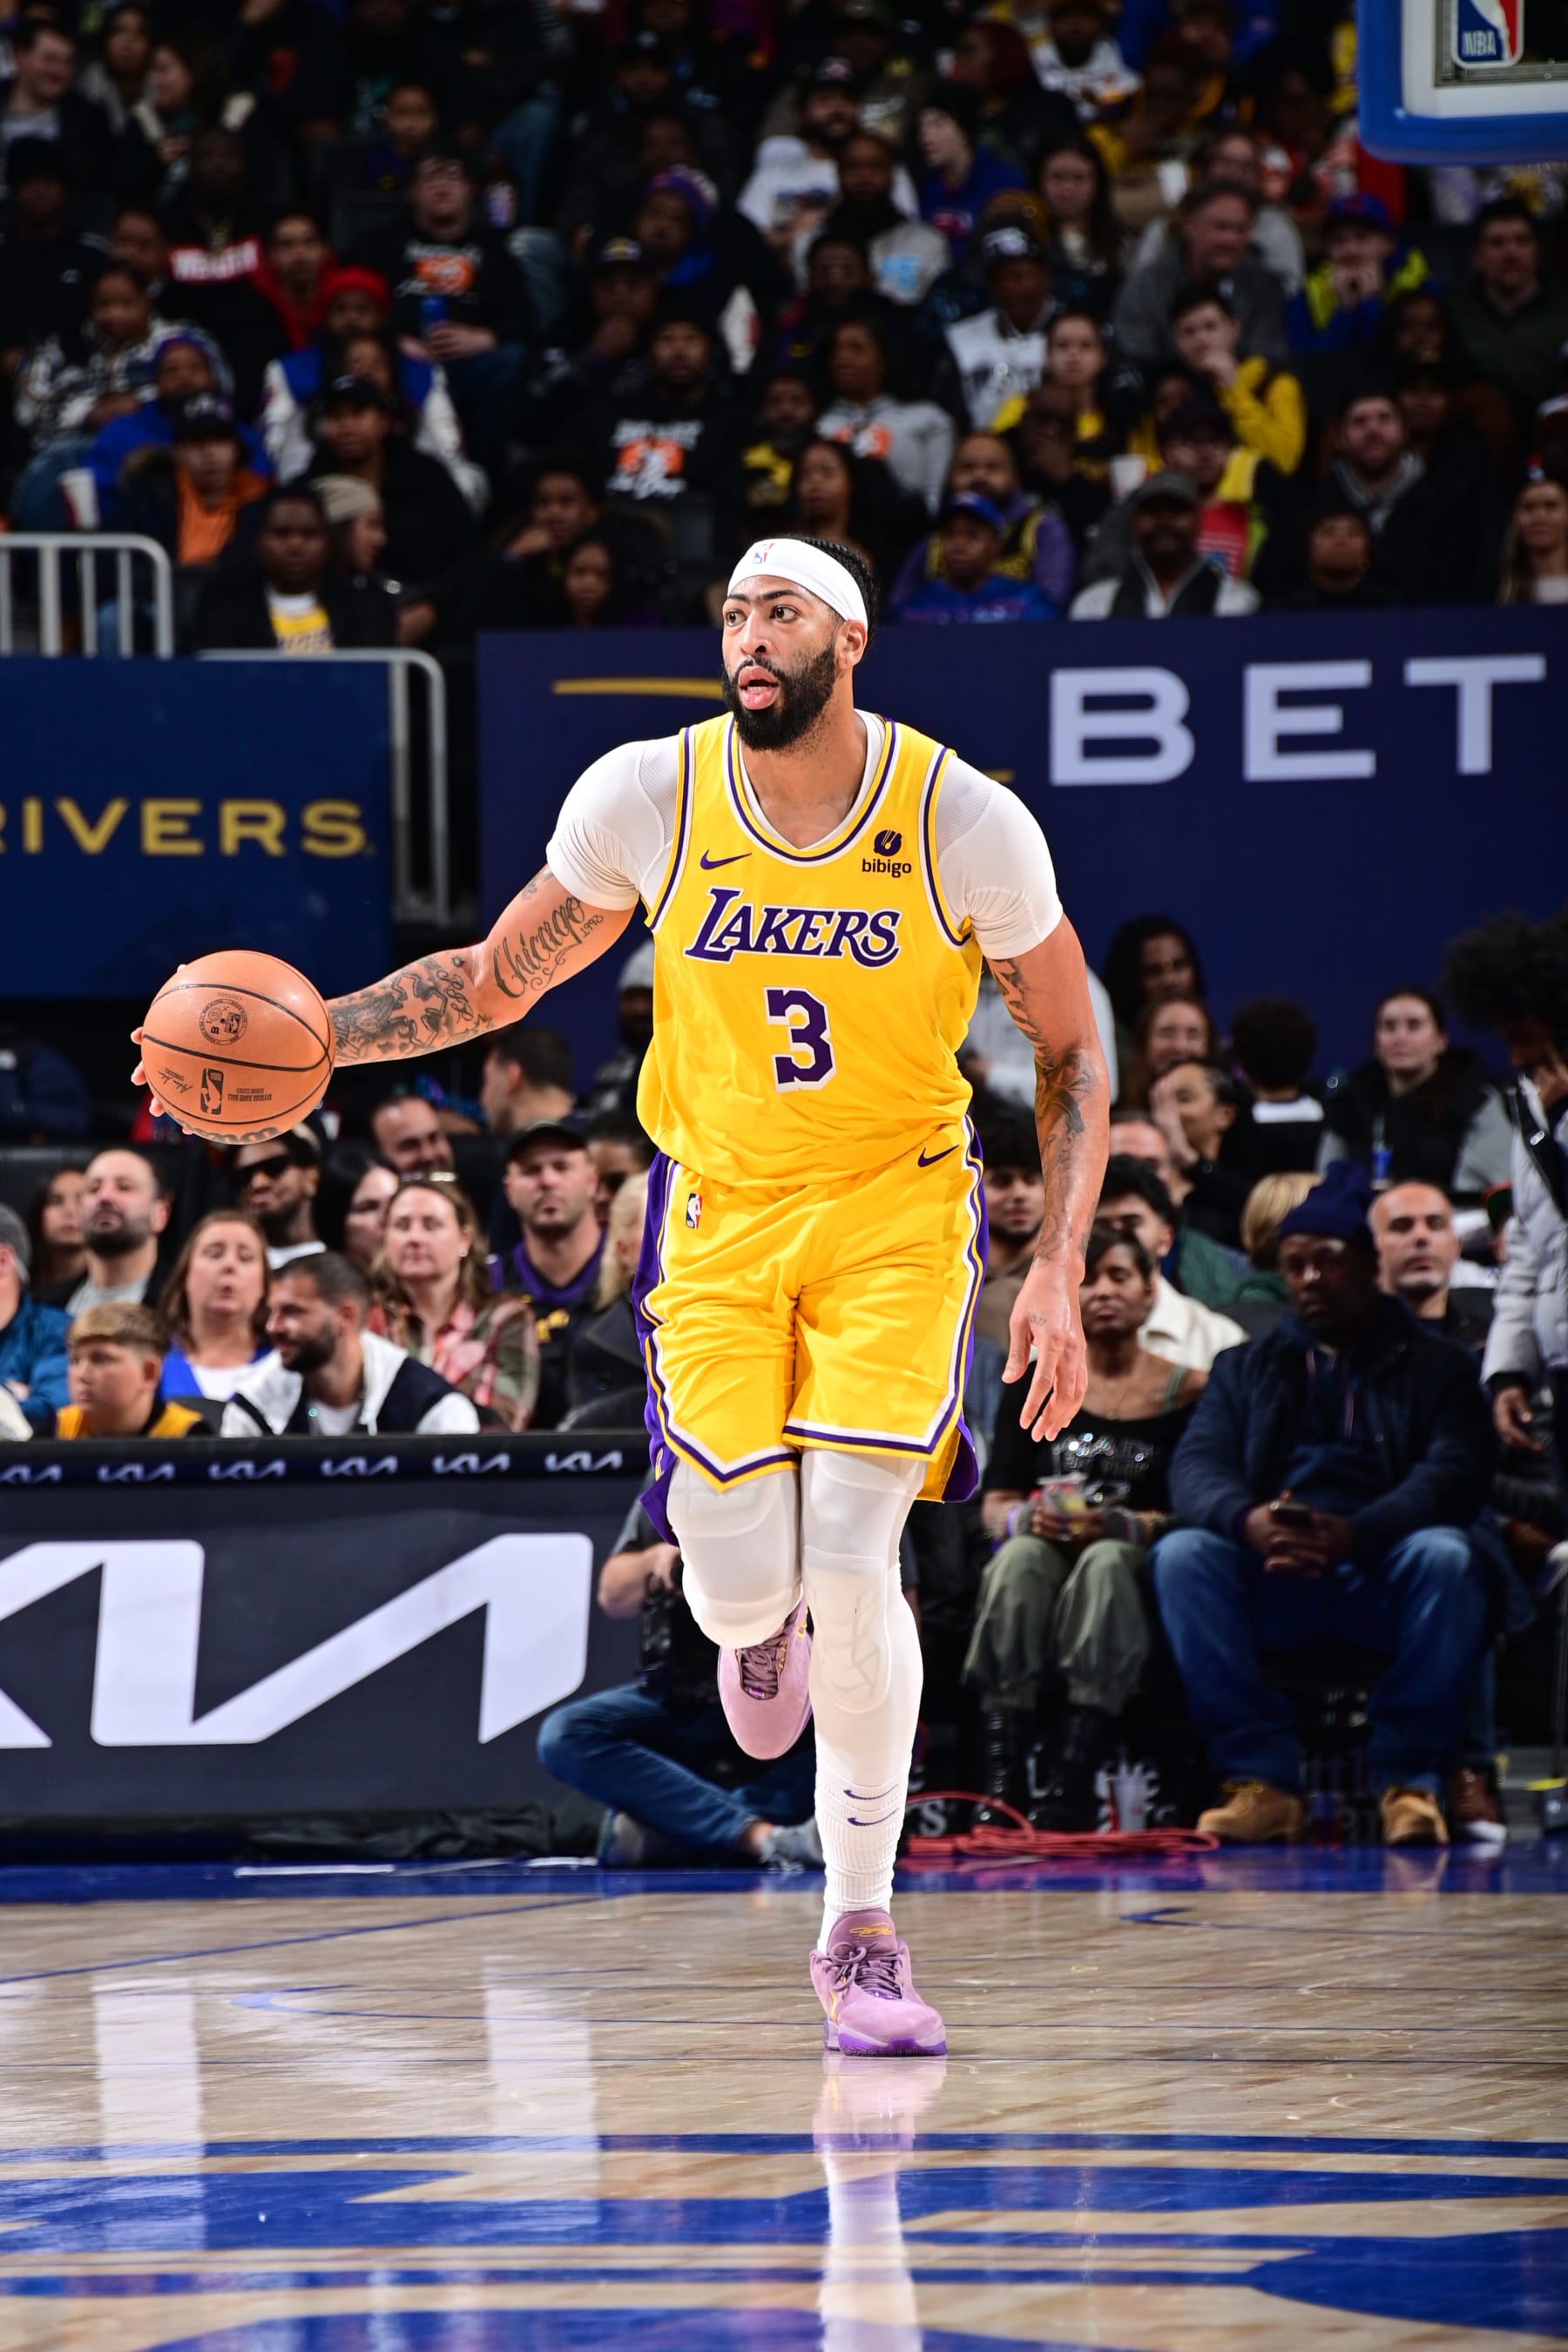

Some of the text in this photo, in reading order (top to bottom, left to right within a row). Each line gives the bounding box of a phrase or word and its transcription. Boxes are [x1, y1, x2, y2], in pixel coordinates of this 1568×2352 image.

[1463, 30, 1497, 57] NBA
[1051, 653, 1546, 786] BET
[0, 797, 367, 858] IVERS
[862, 858, 912, 878] bibigo
[684, 886, 902, 968] LAKERS
[763, 985, 837, 1094] 3
